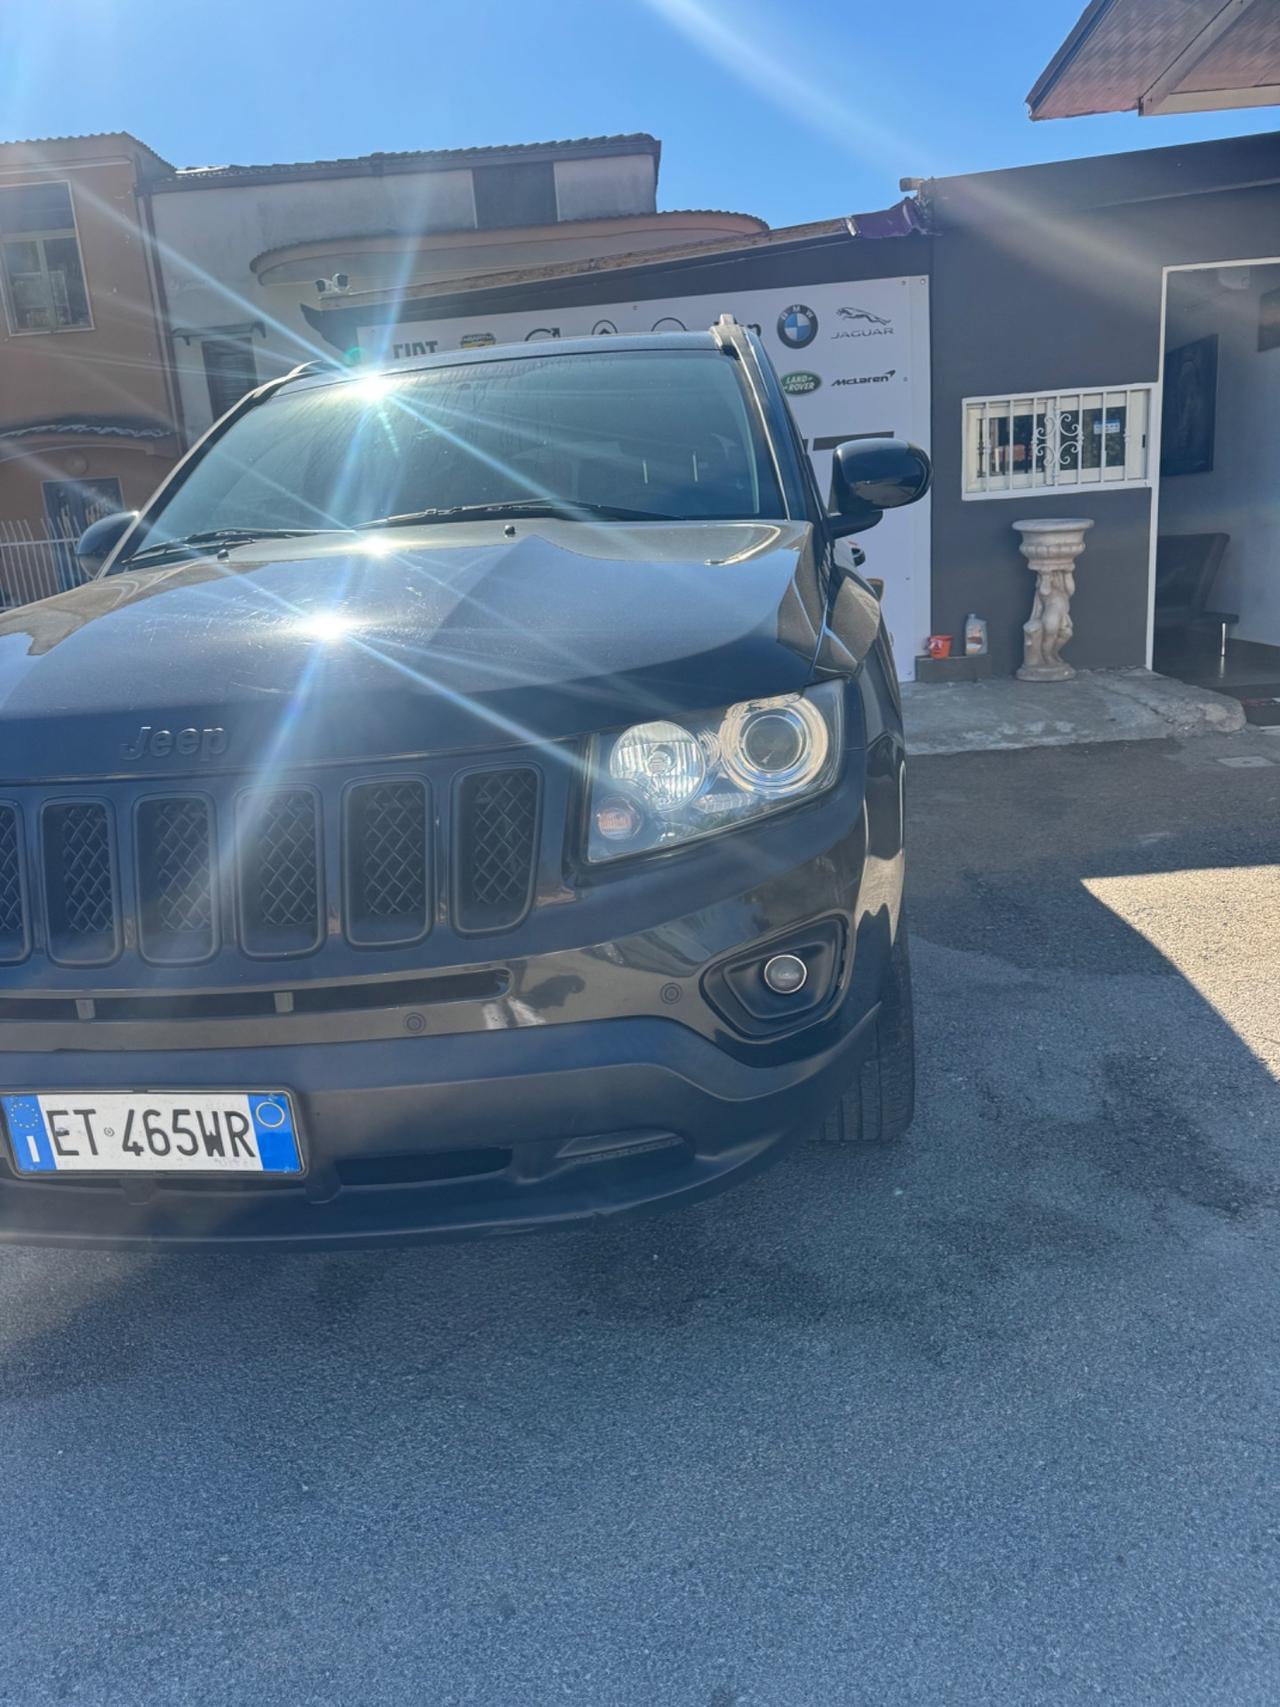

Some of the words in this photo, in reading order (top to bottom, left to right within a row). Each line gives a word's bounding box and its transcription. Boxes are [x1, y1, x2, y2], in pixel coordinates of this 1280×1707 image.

[780, 306, 814, 320] BMW
[831, 328, 894, 340] JAGUAR
[392, 340, 438, 359] FIAT
[786, 375, 809, 384] LAND
[831, 375, 890, 387] McLaren
[788, 382, 815, 392] ROVER
[119, 725, 226, 761] Jeep
[47, 1108, 98, 1156] ET
[122, 1108, 256, 1158] 465WR
